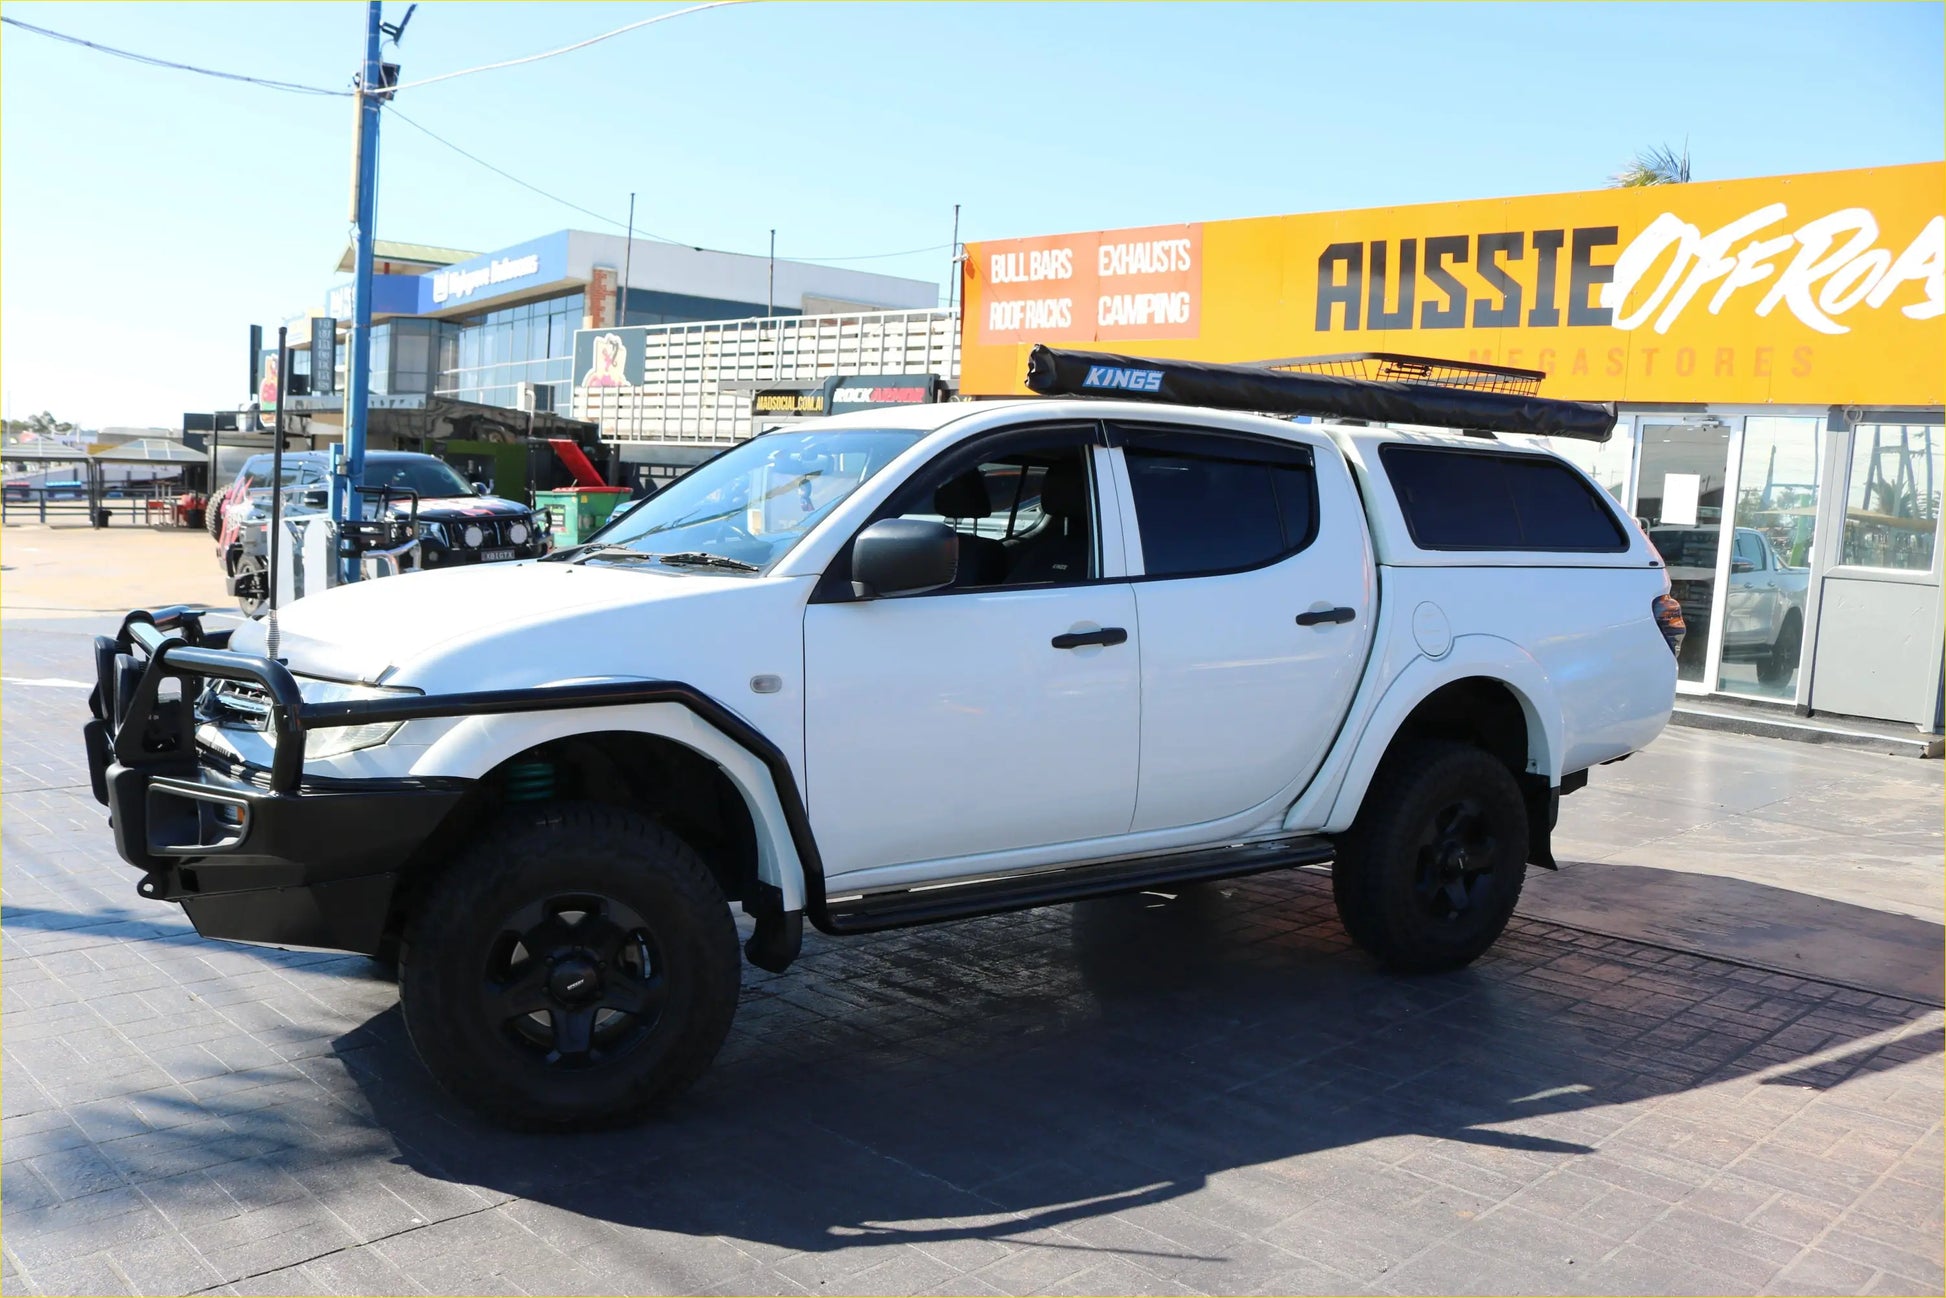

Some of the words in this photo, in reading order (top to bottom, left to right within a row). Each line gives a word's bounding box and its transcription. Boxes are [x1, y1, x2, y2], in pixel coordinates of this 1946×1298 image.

[991, 253, 1028, 283] BULL
[1030, 248, 1073, 280] BARS
[1098, 239, 1191, 276] EXHAUSTS
[1315, 226, 1618, 331] AUSSIE
[1600, 202, 1945, 334] OFFROA
[989, 300, 1024, 330] ROOF
[1025, 298, 1072, 329] RACKS
[1098, 292, 1190, 326] CAMPING
[1085, 367, 1164, 390] KINGS
